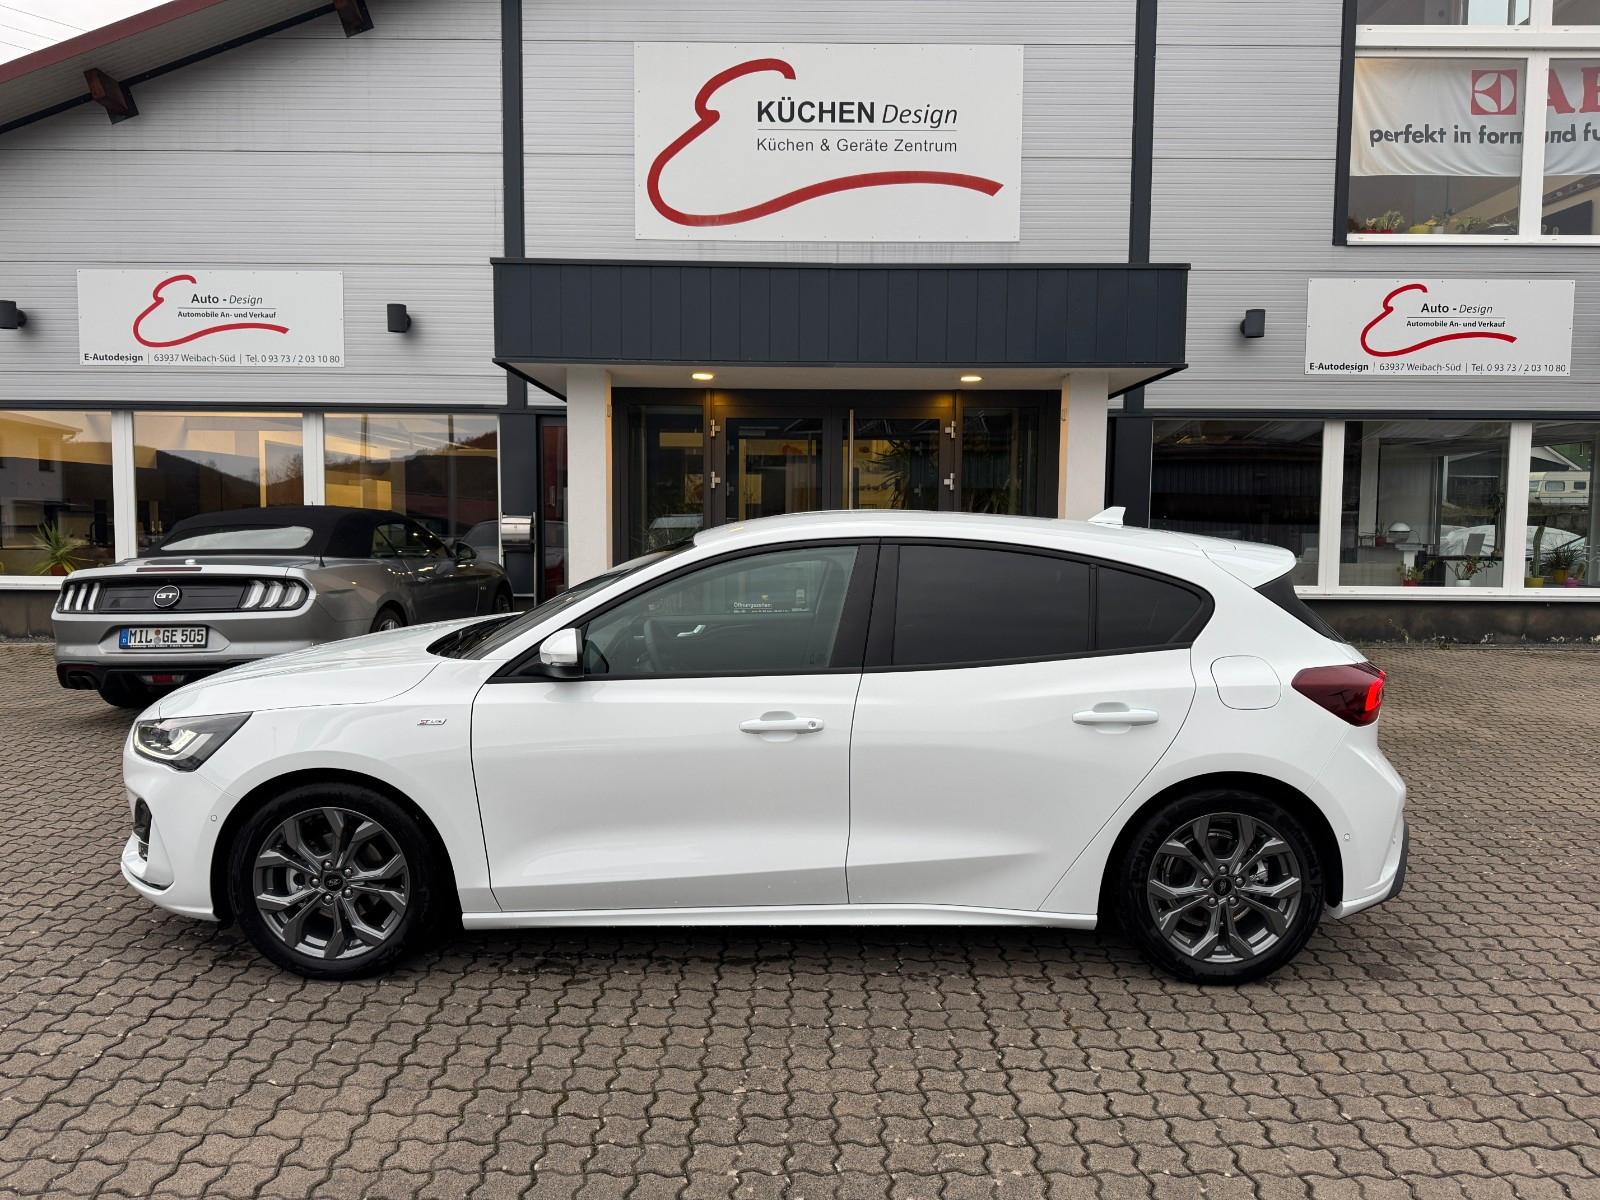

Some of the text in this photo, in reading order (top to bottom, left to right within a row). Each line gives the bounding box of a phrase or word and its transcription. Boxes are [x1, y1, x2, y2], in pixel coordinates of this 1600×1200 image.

[757, 96, 958, 129] KÜCHEN Design
[1369, 123, 1447, 148] perfekt
[1453, 124, 1472, 144] in
[757, 137, 957, 153] Küchen & Geräte Zentrum
[191, 293, 220, 304] Auto
[229, 294, 263, 307] Design
[248, 311, 277, 319] Verkauf
[1420, 303, 1450, 313] Auto
[1459, 304, 1493, 316] Design
[1477, 320, 1506, 328] Verkauf
[83, 352, 144, 363] E-Autodesign
[153, 353, 179, 362] 63937
[244, 354, 260, 363] Tel.
[260, 354, 267, 363] 0
[268, 354, 279, 363] 93
[280, 354, 291, 363] 73
[304, 354, 316, 364] 03
[317, 354, 328, 364] 10
[329, 354, 341, 364] 80
[1308, 362, 1369, 373] E-Autodesign
[1379, 363, 1405, 371] 63937
[1471, 363, 1485, 372] Tel.
[1486, 363, 1493, 372] 0
[1494, 363, 1505, 372] 93
[1506, 363, 1517, 372] 73
[1531, 364, 1542, 372] 03
[1544, 364, 1554, 372] 10
[1555, 364, 1566, 372] 80
[129, 629, 153, 644] MIL
[162, 629, 178, 643] GE
[180, 629, 205, 643] 505
